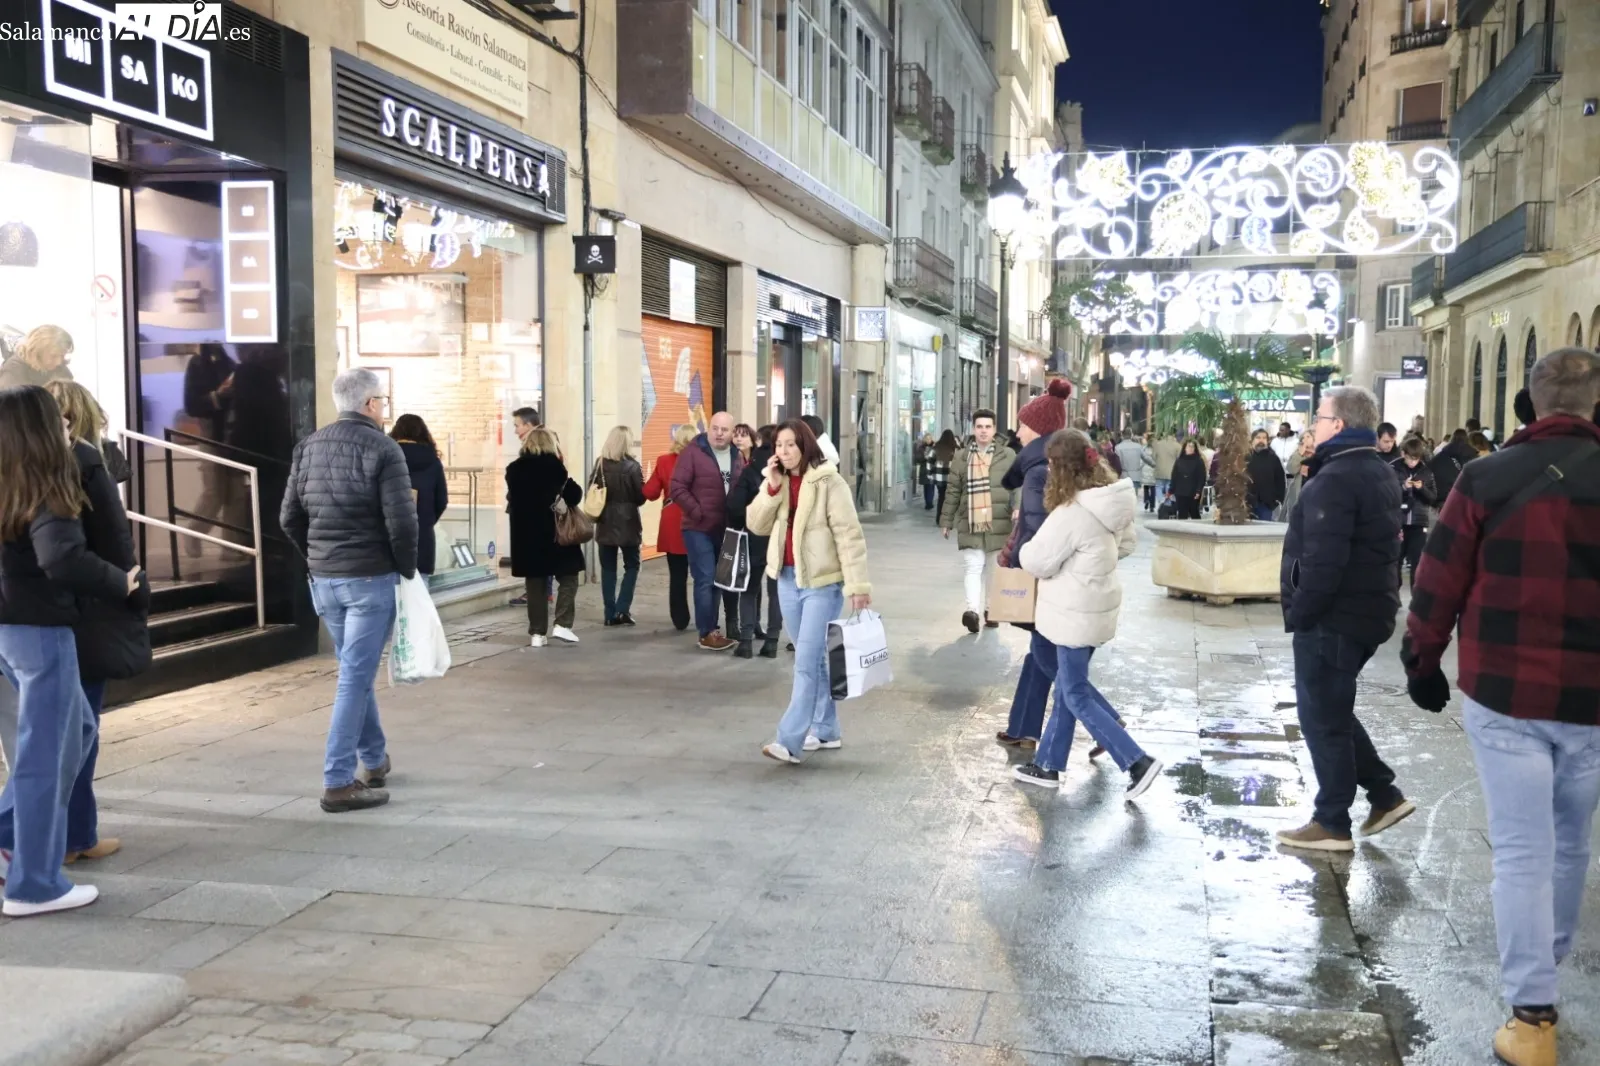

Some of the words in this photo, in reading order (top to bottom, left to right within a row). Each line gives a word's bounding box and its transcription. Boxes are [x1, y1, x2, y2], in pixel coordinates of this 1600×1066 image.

[447, 12, 481, 47] Rascón
[483, 32, 527, 72] Salamanca
[450, 44, 474, 67] Laboral
[120, 55, 149, 85] SA
[171, 72, 199, 101] KO
[380, 98, 533, 190] SCALPERS
